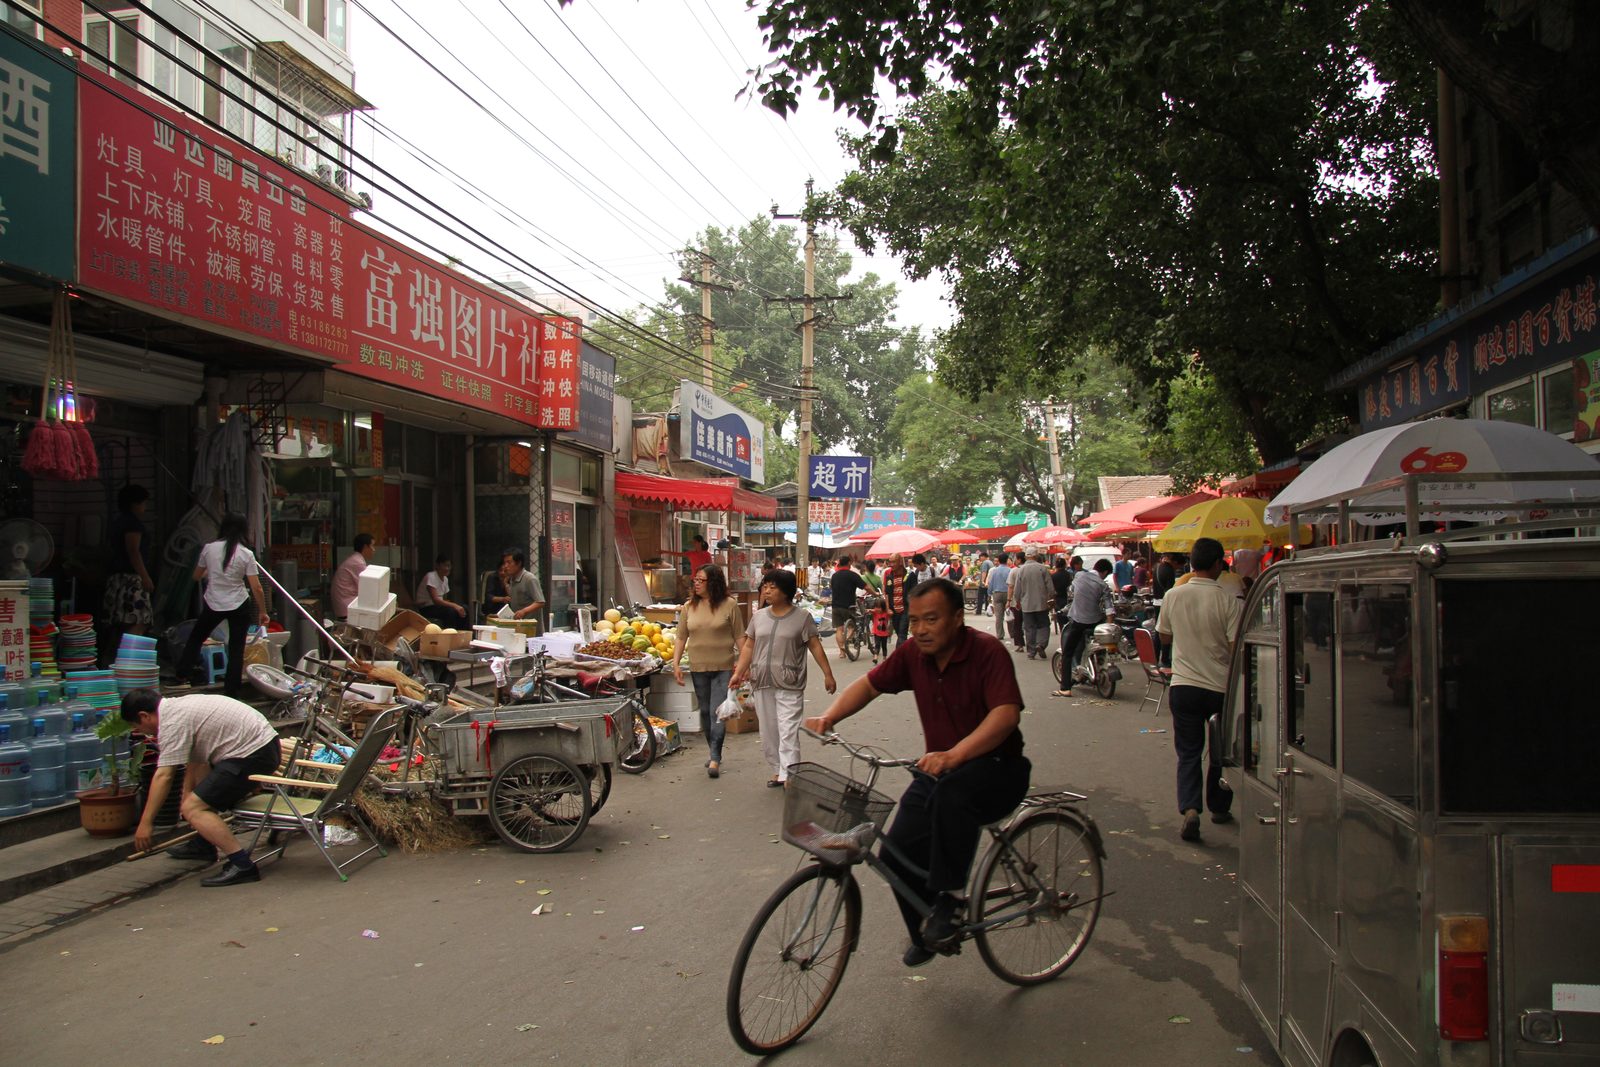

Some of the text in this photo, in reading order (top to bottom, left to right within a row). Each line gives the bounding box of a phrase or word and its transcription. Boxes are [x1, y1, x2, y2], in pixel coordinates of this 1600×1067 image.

[360, 246, 540, 386] 富强图片社
[359, 343, 425, 380] 数码冲洗
[541, 321, 557, 427] 数码冲洗
[557, 321, 574, 427] 证件快照
[441, 370, 493, 402] 证件快照
[811, 461, 868, 494] 超市
[5, 648, 25, 666] IP卡
